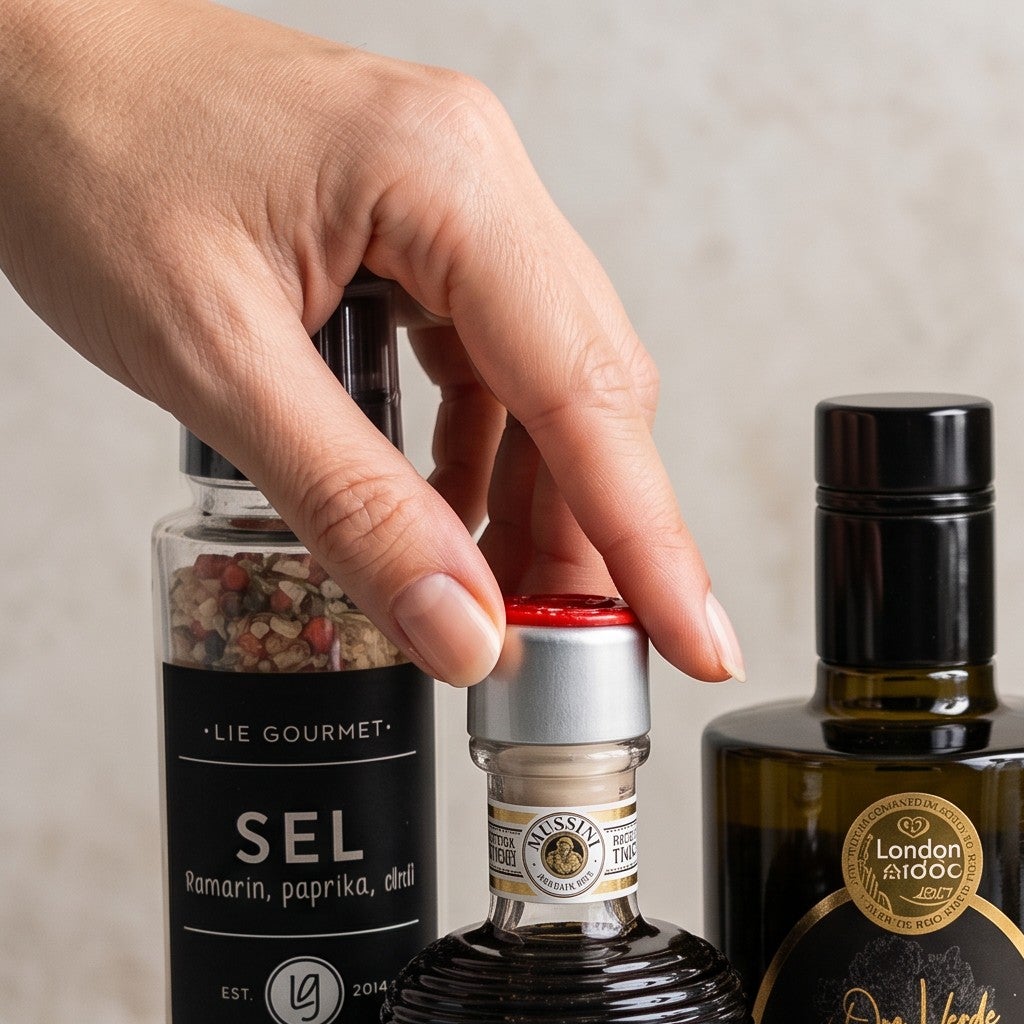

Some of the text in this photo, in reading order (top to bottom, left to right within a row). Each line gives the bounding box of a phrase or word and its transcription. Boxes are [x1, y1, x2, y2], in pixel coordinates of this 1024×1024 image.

[214, 719, 384, 743] LIE GOURMET
[235, 809, 364, 864] SEL
[527, 816, 601, 852] MUSSINI
[877, 838, 961, 860] London
[282, 873, 375, 908] paprika,
[222, 980, 387, 1001] EST. 2014
